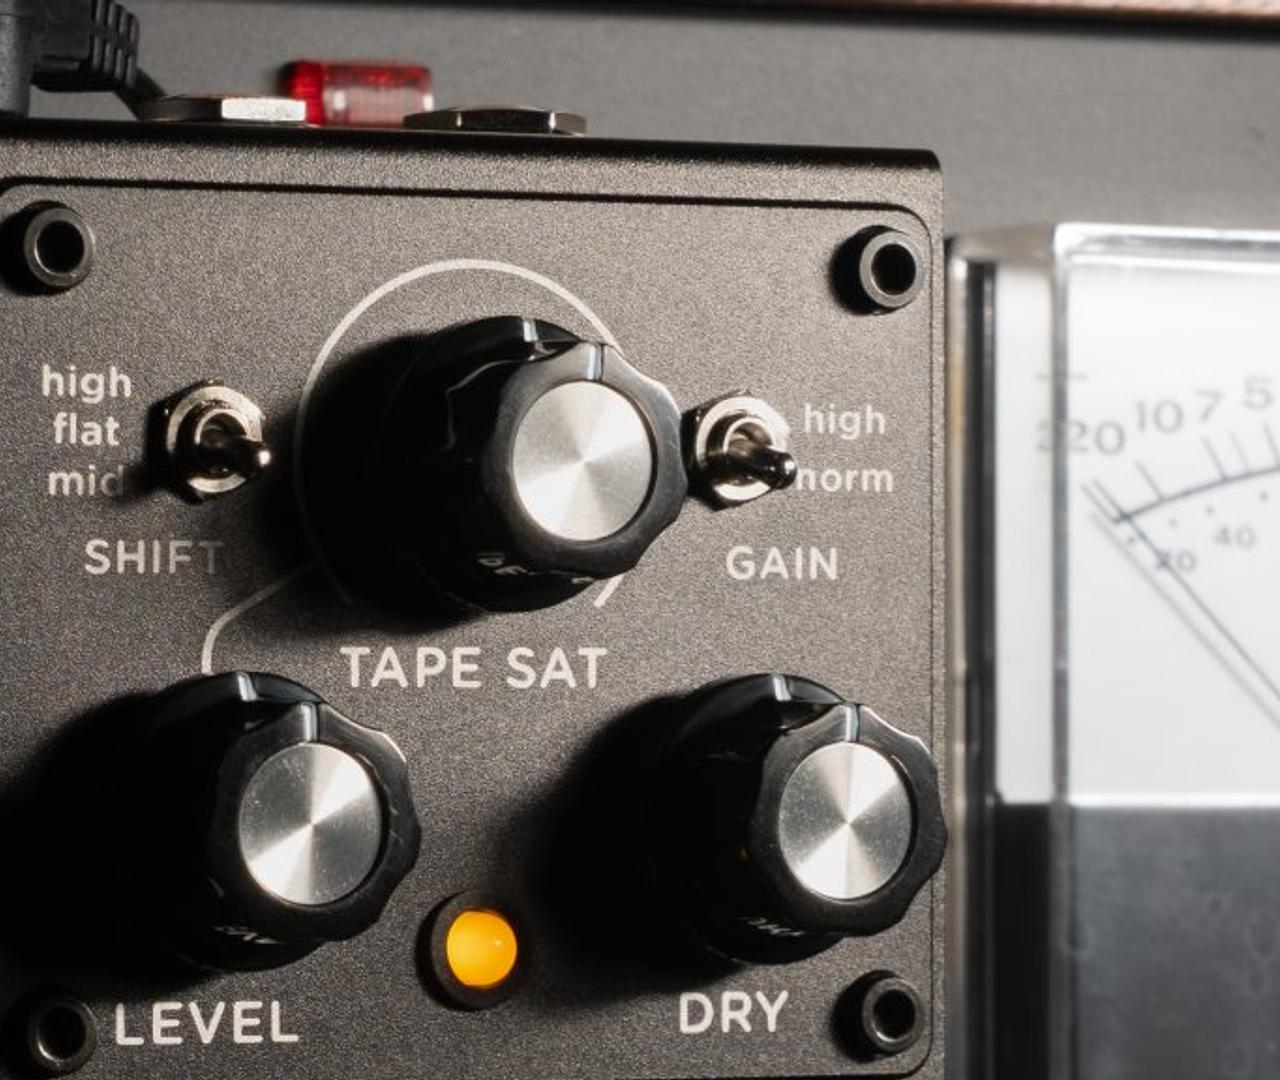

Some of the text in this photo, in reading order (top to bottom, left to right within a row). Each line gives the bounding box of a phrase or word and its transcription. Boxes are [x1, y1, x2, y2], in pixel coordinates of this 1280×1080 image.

[40, 364, 132, 405] high
[802, 403, 887, 442] high
[1135, 398, 1185, 435] 10
[1194, 389, 1224, 423] 7
[1243, 375, 1276, 411] 5
[52, 412, 121, 447] flat
[796, 466, 895, 494] norm
[83, 539, 226, 575] SHIFT
[1212, 526, 1257, 549] 40
[724, 545, 840, 582] GAIN
[339, 646, 610, 690] TAPE SAT
[113, 1000, 301, 1046] LEVEL
[677, 990, 790, 1035] DRY
